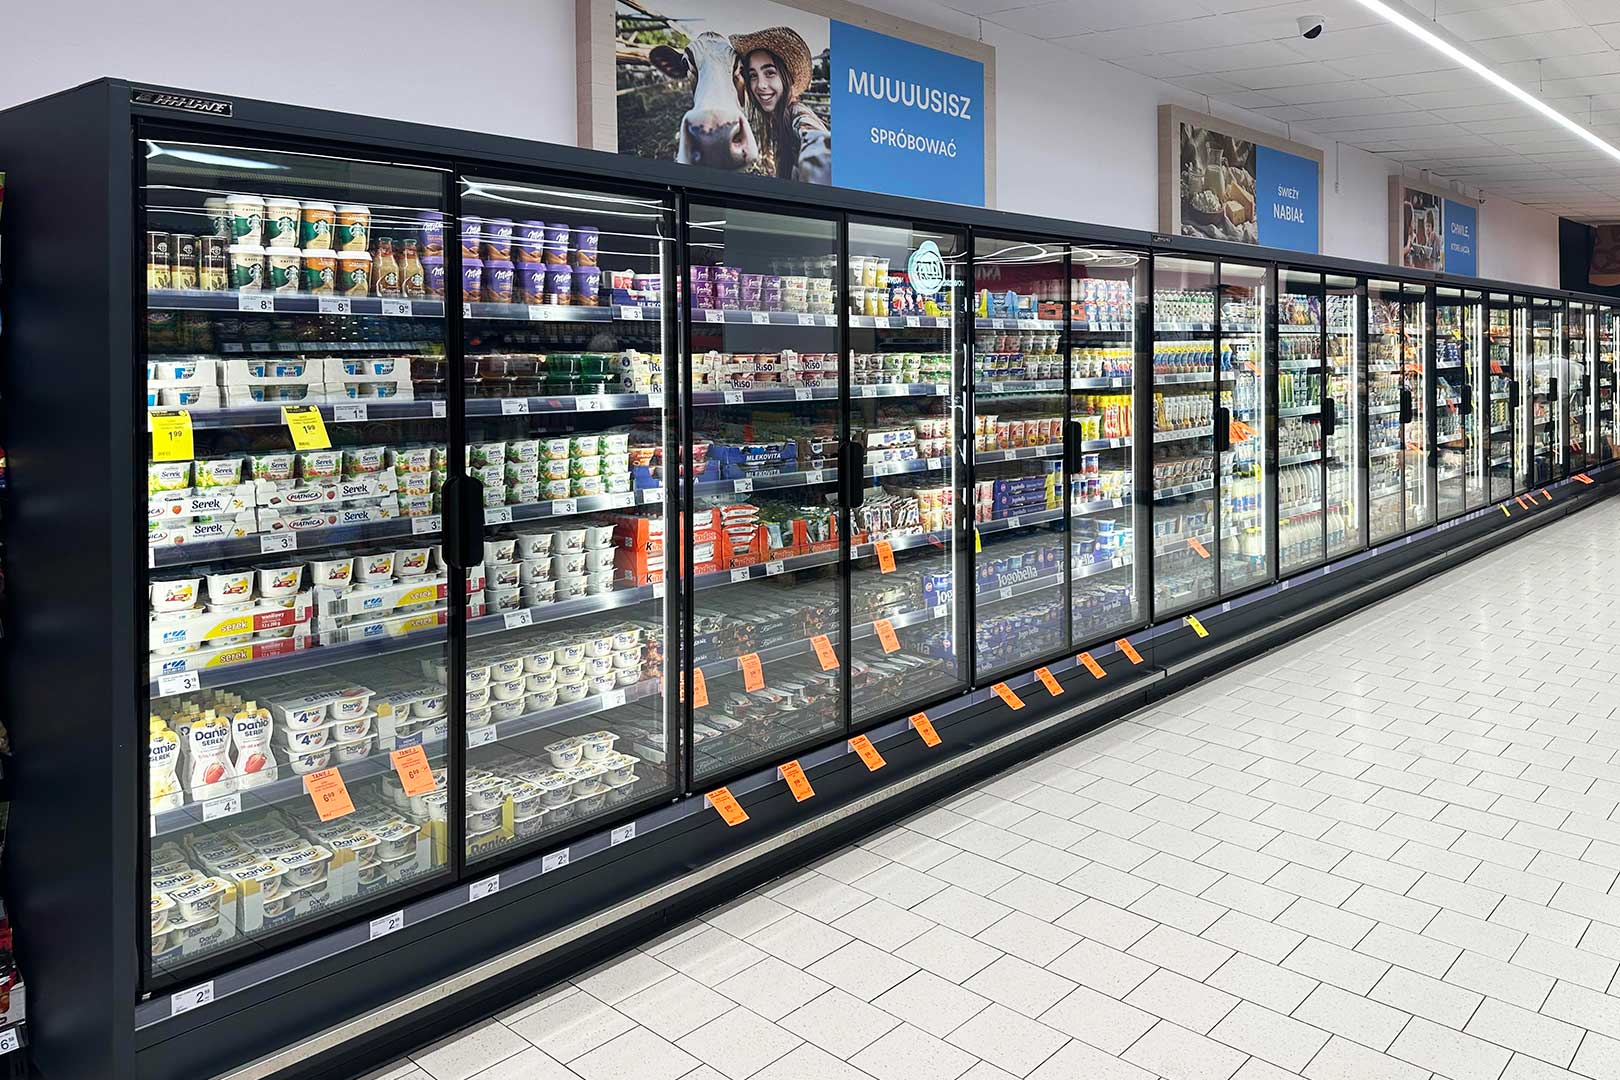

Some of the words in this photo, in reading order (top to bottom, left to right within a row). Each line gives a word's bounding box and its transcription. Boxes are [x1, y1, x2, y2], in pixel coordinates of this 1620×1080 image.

[848, 68, 971, 120] MUUUUSISZ
[870, 127, 957, 158] SPRÓBOWAĆ
[1273, 203, 1304, 224] NABIAŁ
[746, 453, 781, 461] MLEKOVITA
[343, 484, 368, 495] Serek
[191, 499, 220, 510] Serek
[345, 511, 369, 521] Serek
[194, 524, 223, 535] Serek
[221, 620, 248, 632] serek
[220, 651, 247, 662] serek
[299, 713, 308, 723] 4
[237, 719, 269, 732] Danio
[195, 728, 228, 741] Danio
[244, 728, 265, 737] SEREK
[202, 738, 224, 747] SEREK
[301, 735, 311, 745] 4
[304, 756, 314, 766] 4
[332, 835, 367, 847] Danio
[218, 855, 256, 870] Danio
[282, 849, 316, 864] Danio
[236, 865, 273, 878] Danio
[153, 873, 191, 887] Danio
[177, 882, 215, 899] Danio
